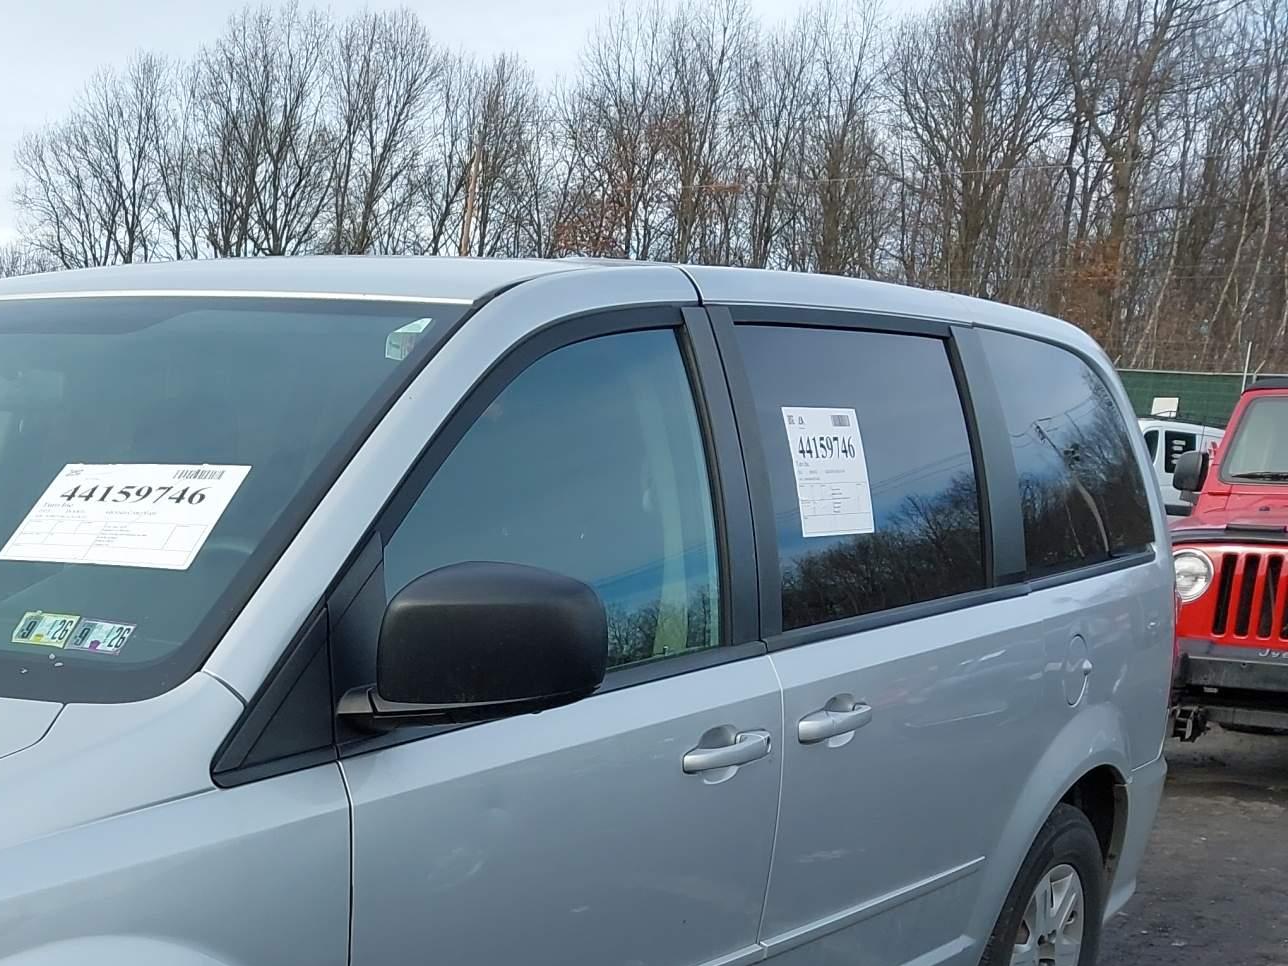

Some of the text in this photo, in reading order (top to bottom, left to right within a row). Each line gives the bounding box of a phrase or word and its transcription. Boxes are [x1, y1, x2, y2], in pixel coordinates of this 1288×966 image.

[798, 436, 856, 459] 44159746
[61, 484, 213, 505] 44159746
[51, 619, 74, 641] 26
[107, 627, 131, 648] 26
